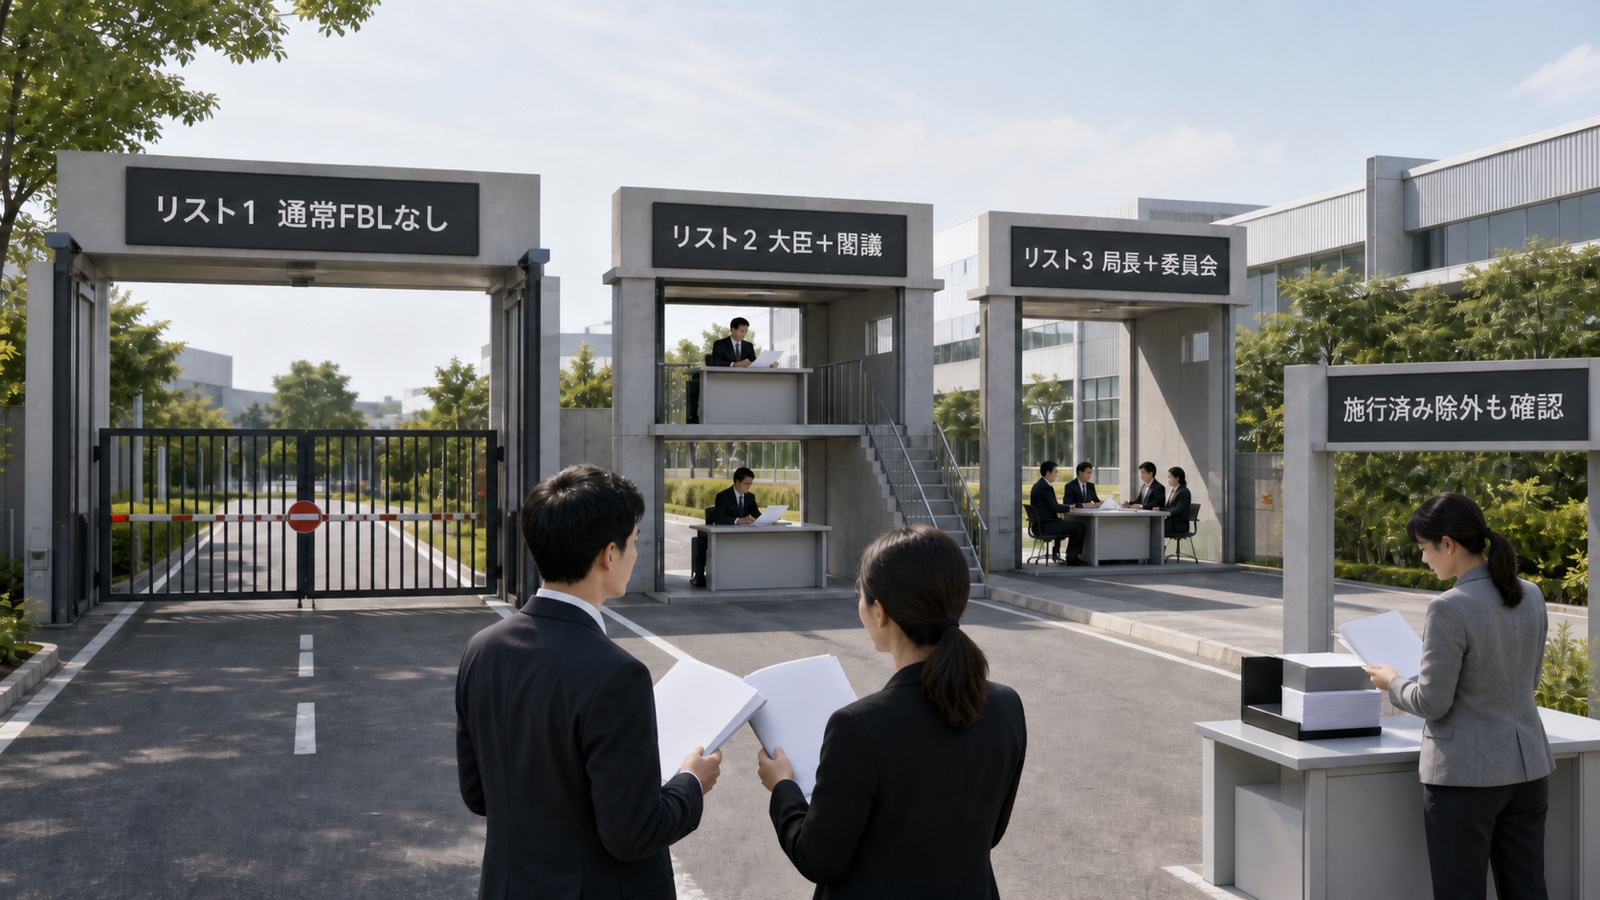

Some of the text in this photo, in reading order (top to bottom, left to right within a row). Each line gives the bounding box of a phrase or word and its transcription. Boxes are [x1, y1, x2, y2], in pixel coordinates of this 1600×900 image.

[157, 195, 448, 232] リスト1 通常FBLなし
[673, 225, 883, 257] リスト2 大臣＋閣議
[1025, 247, 1218, 277] リスト3 局長＋委員会
[1343, 393, 1565, 423] 施行済み除外も確認
